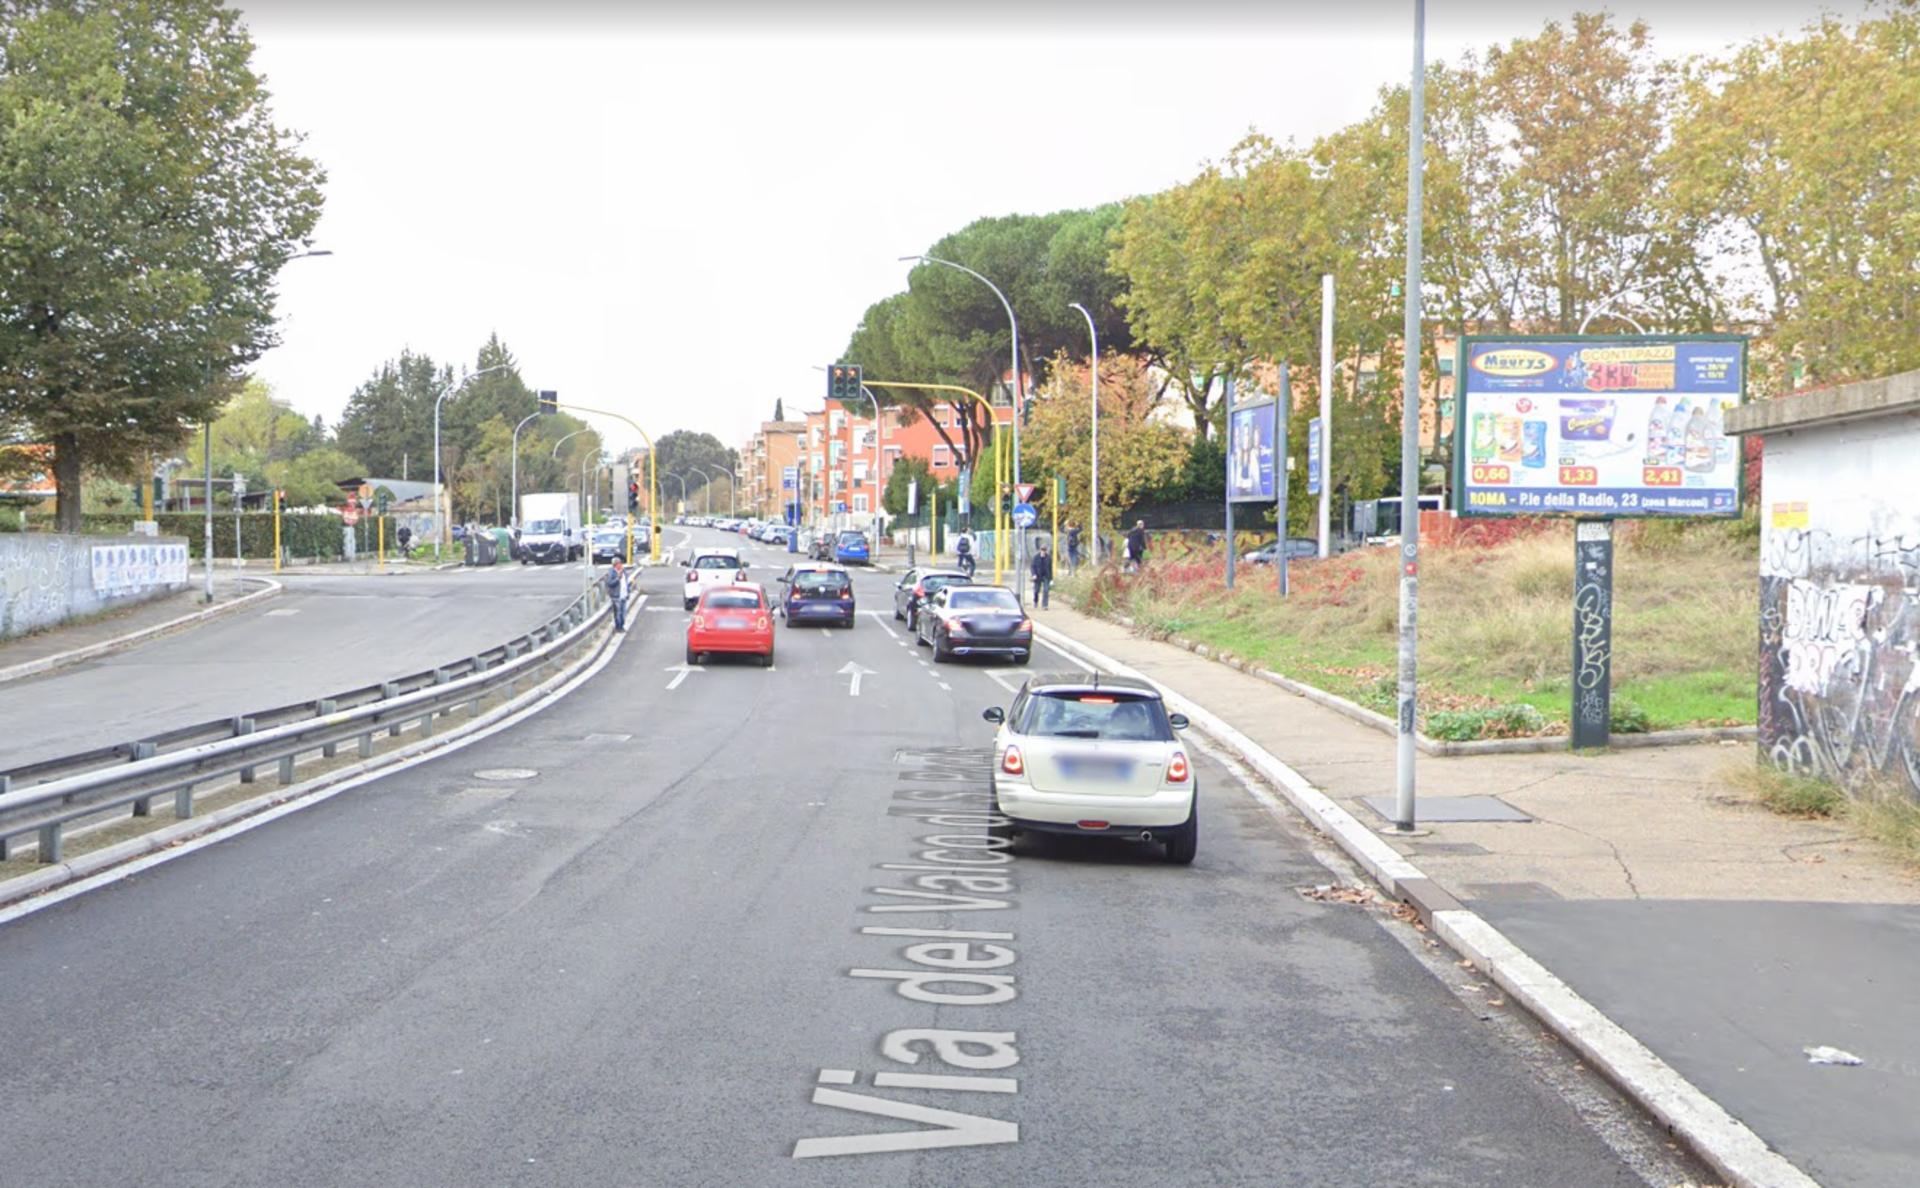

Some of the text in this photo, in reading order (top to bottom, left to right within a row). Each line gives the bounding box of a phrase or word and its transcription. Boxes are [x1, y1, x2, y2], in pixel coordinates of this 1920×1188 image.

[1474, 467, 1508, 484] 0,66
[1562, 468, 1594, 483] 1,33
[1645, 469, 1679, 485] 2,41
[1470, 492, 1506, 505] ROMA
[1543, 492, 1575, 506] della
[1578, 492, 1618, 508] Radio,
[1621, 492, 1638, 506] 23
